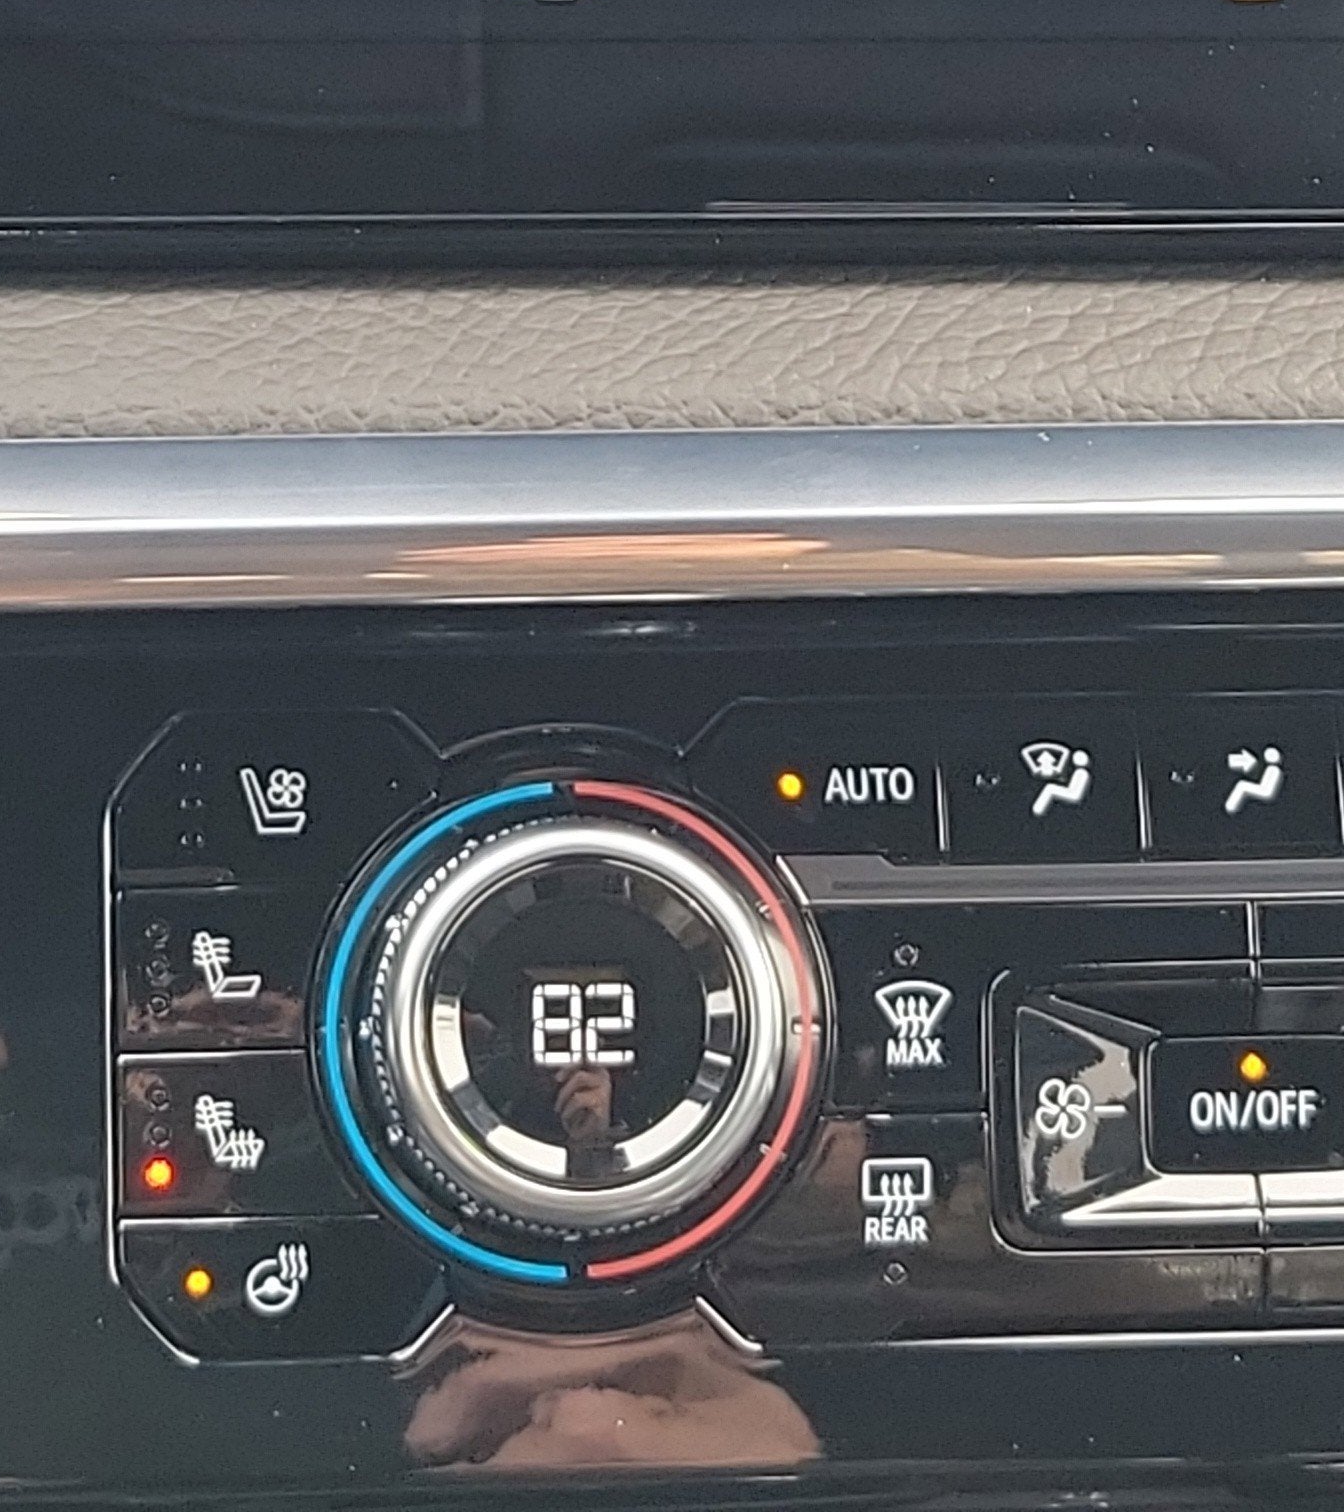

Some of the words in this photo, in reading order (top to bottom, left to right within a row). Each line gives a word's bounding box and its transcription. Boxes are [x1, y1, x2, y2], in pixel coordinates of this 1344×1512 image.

[824, 768, 914, 803] AUTO
[531, 982, 635, 1065] 82
[886, 1039, 942, 1065] MAX
[1191, 1091, 1316, 1130] ON/OFF
[864, 1216, 927, 1242] REAR
